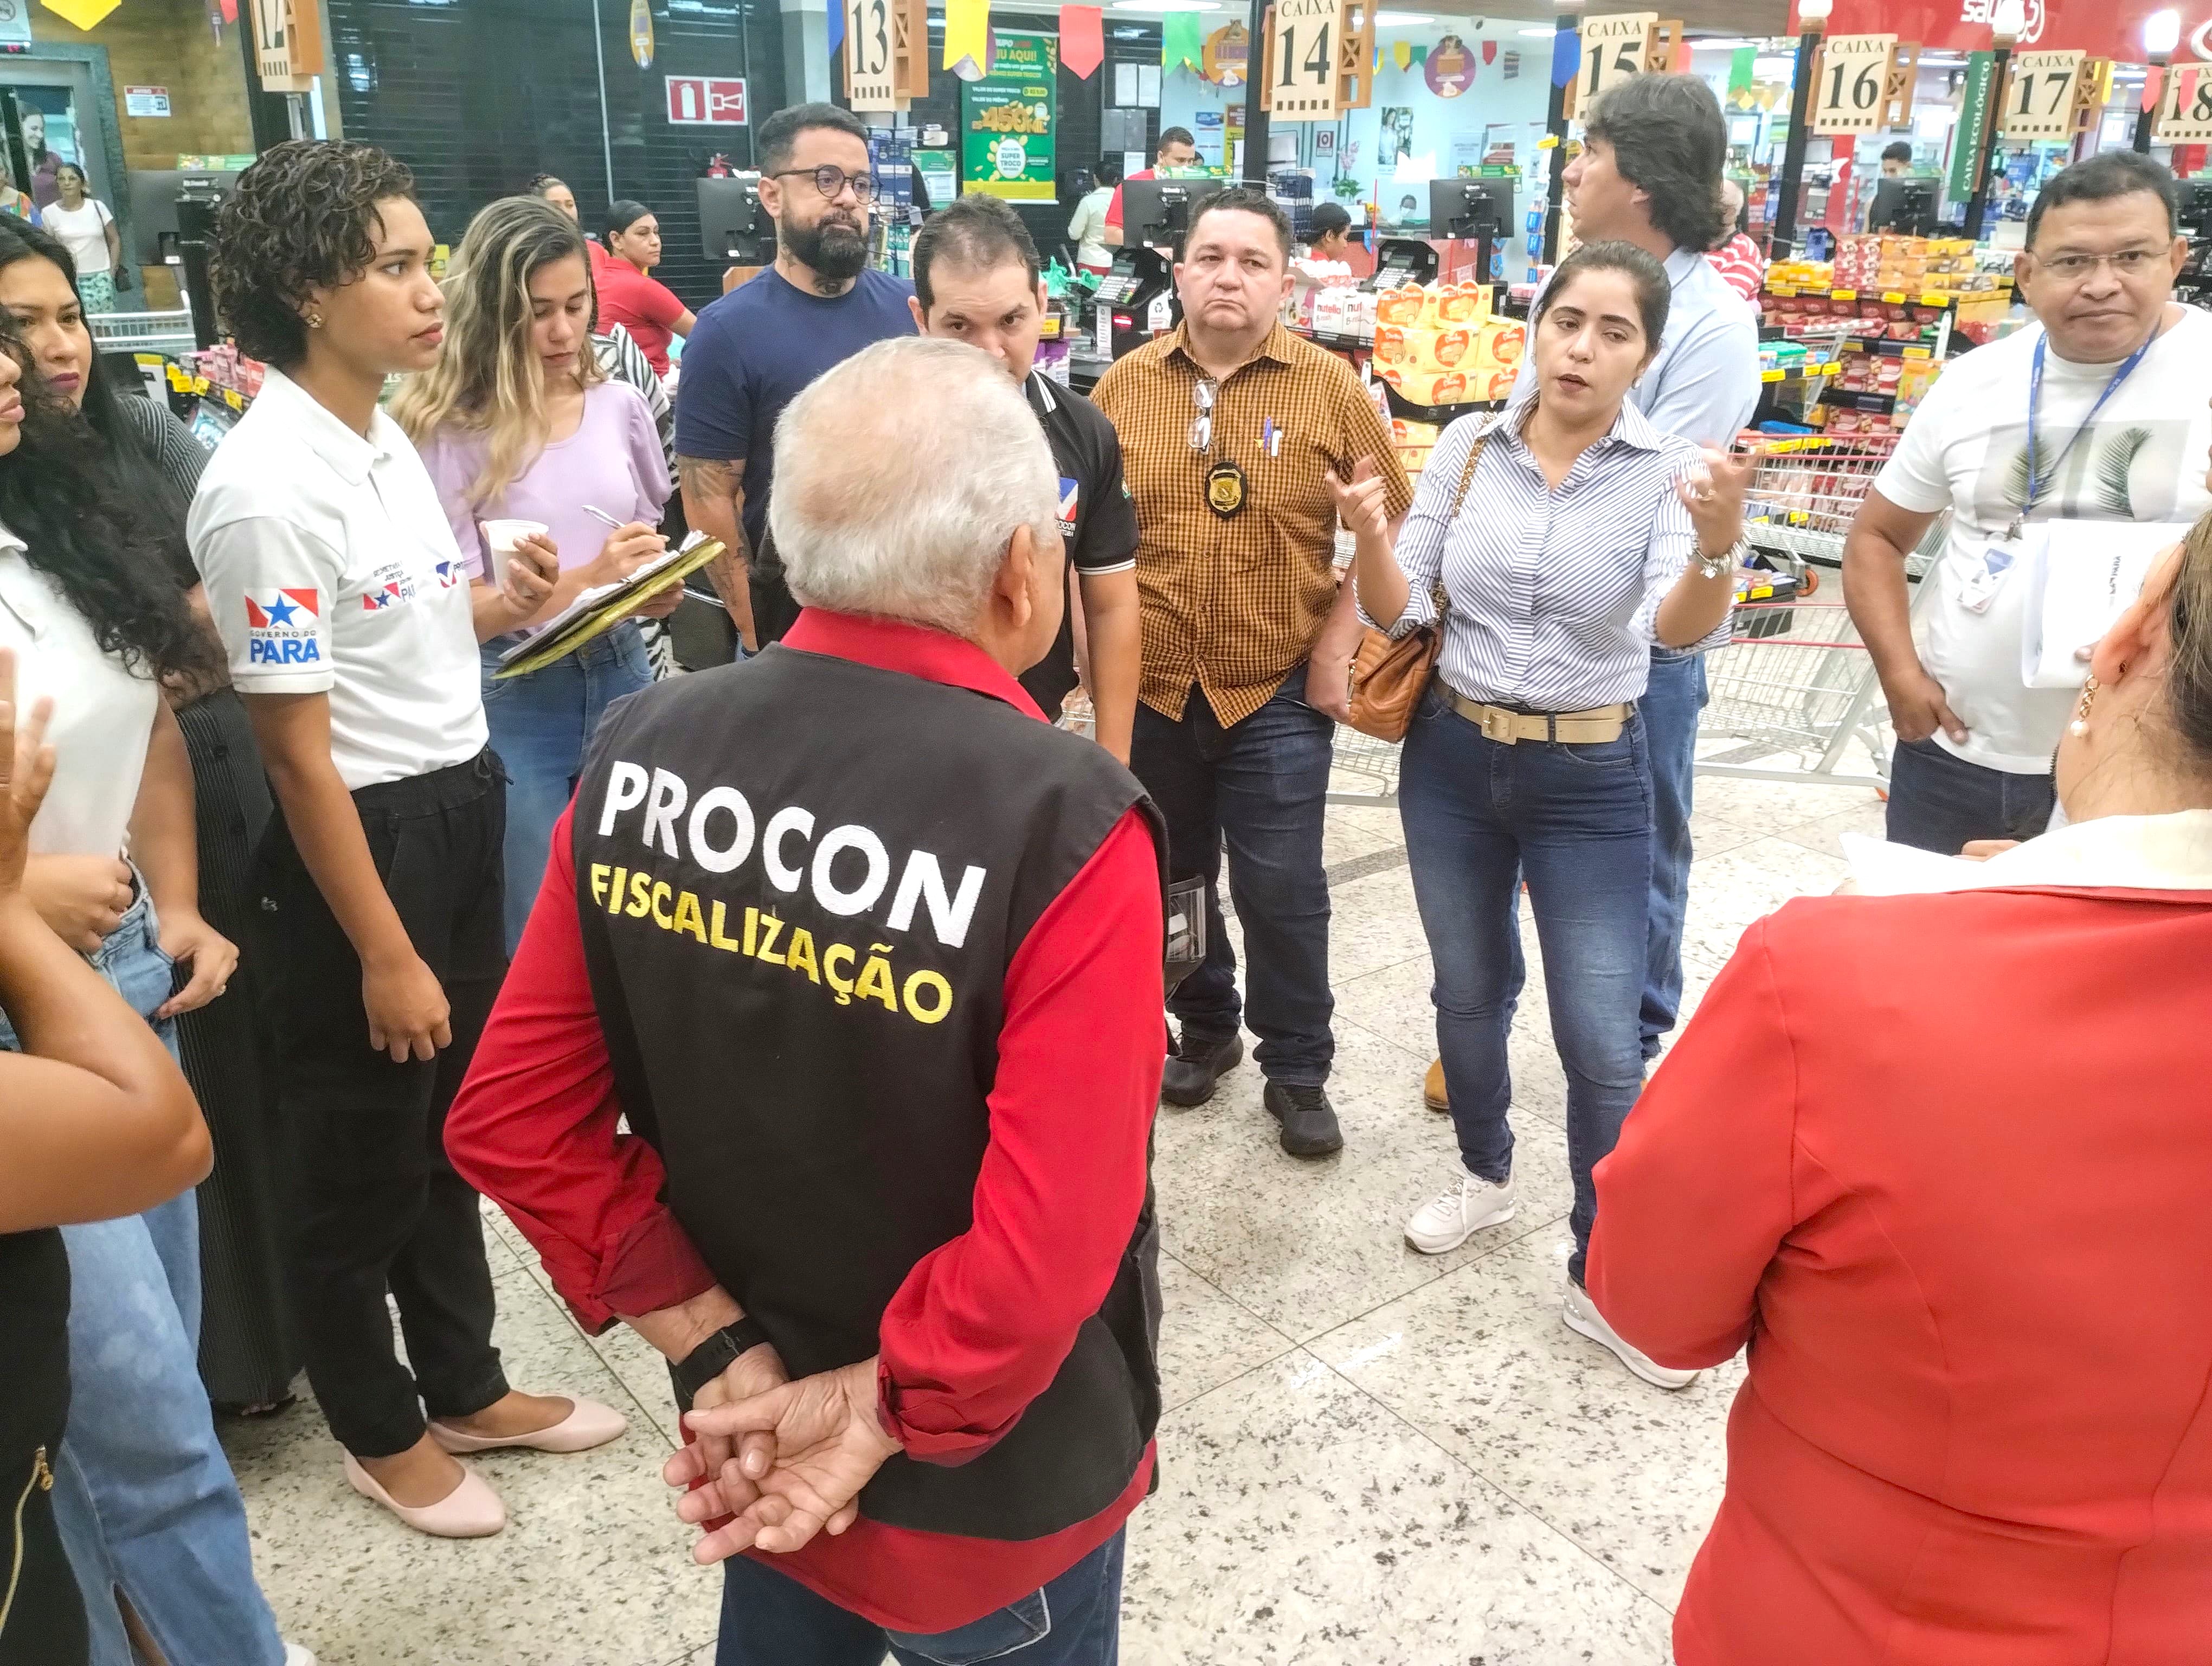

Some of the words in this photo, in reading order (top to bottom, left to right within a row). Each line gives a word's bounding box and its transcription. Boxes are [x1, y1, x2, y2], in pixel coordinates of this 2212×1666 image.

[1281, 0, 1335, 18] CAIXA
[1587, 21, 1642, 38] CAIXA
[852, 0, 889, 75] 13
[1277, 22, 1330, 87] 14
[1831, 40, 1885, 54] CAIXA
[1583, 42, 1641, 98] 15
[2022, 55, 2075, 68] CAIXA
[1823, 61, 1883, 111] 16
[2010, 72, 2073, 116] 17
[1963, 148, 1977, 191] CAIXA
[1317, 304, 1341, 315] nutella
[598, 761, 987, 948] PROCON
[590, 863, 953, 1024] FISCALIZAÇÃO
